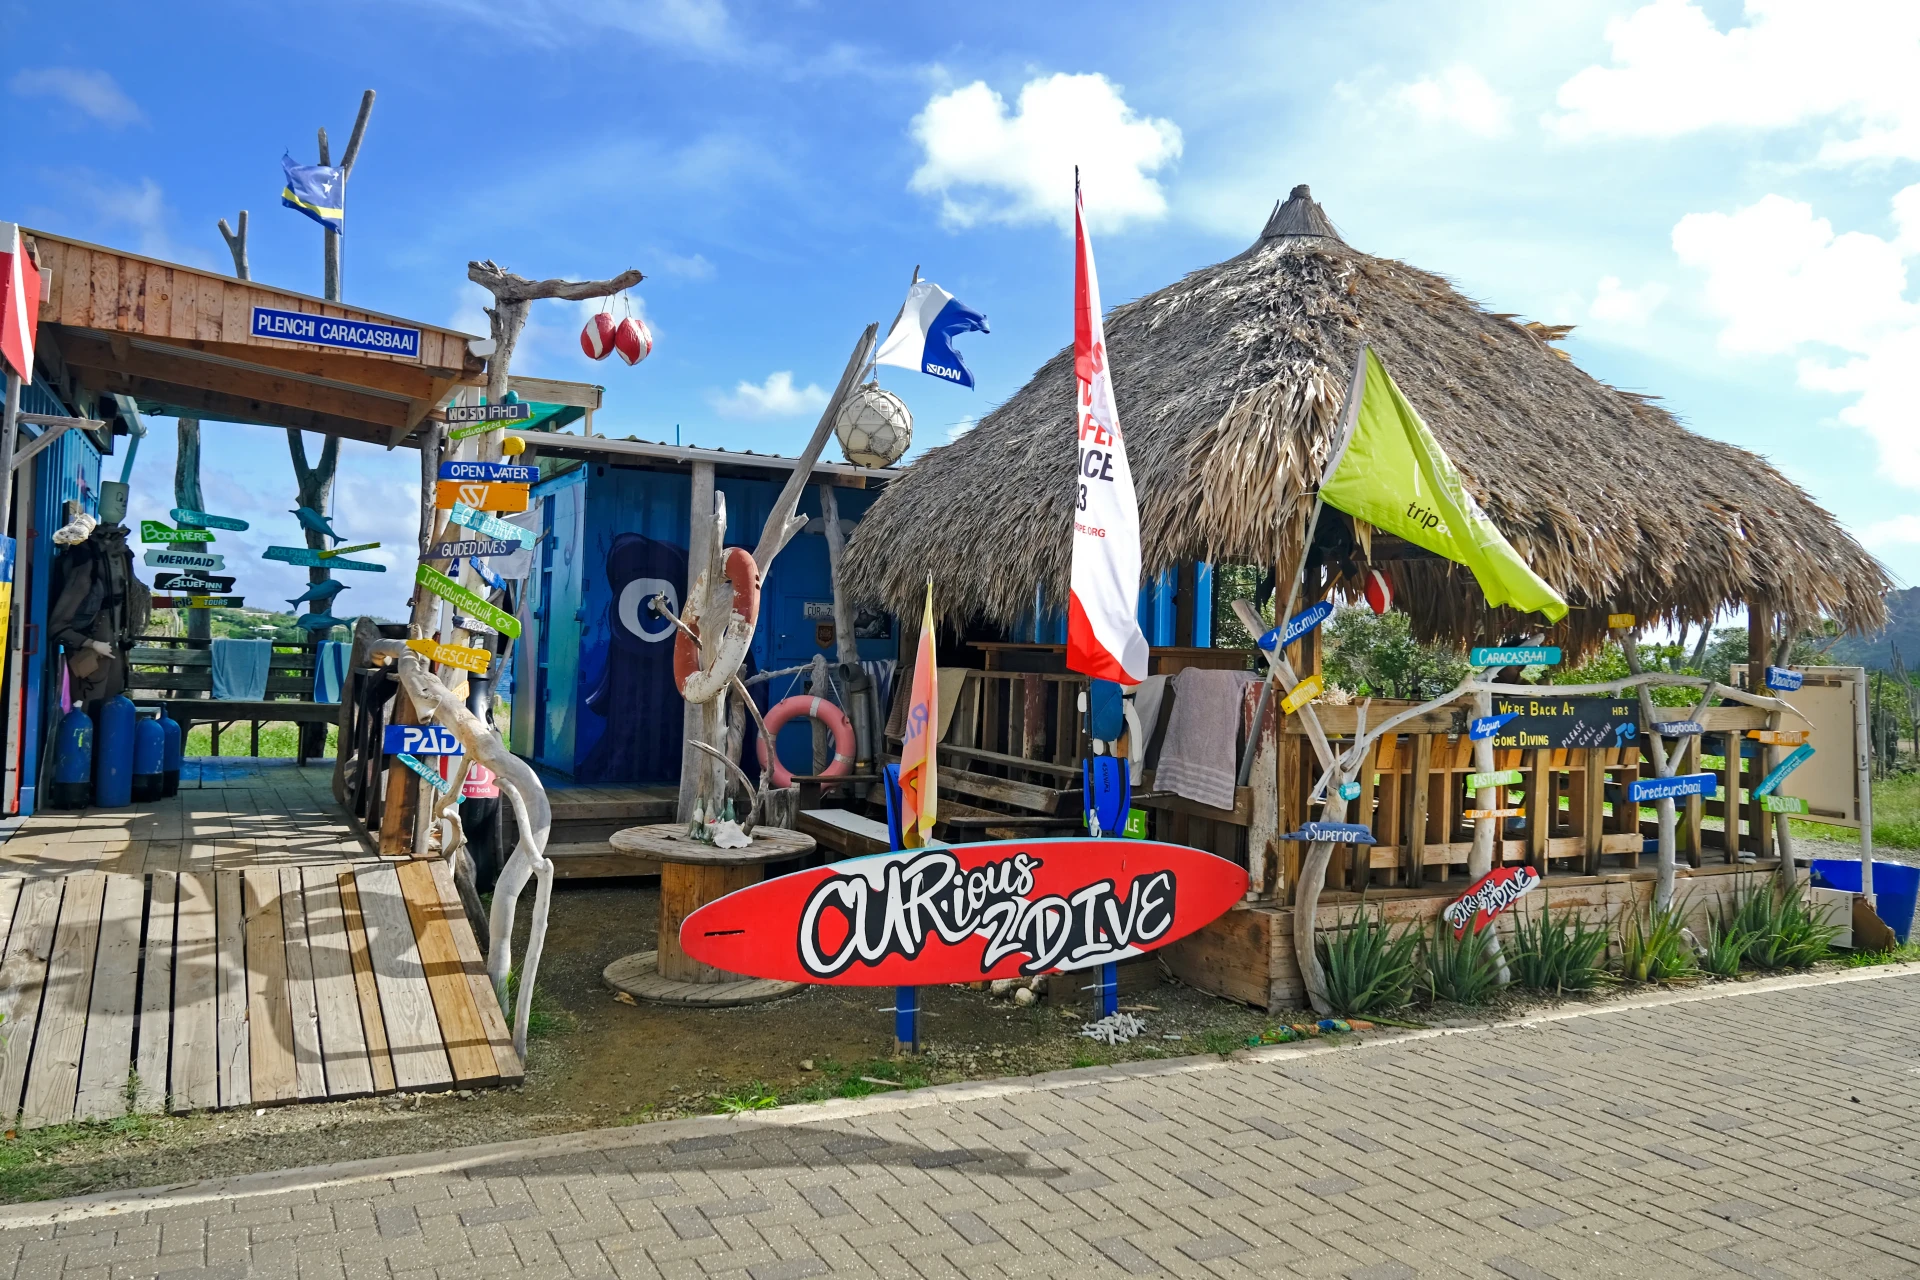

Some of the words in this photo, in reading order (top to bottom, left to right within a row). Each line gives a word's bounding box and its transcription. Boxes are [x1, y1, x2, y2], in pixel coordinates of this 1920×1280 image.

[258, 314, 315, 337] PLENCHI
[320, 323, 414, 350] CARACASBAAI
[936, 365, 961, 380] DAN
[460, 421, 502, 437] advanced
[451, 465, 485, 477] OPEN
[489, 466, 529, 479] WATER
[456, 485, 489, 508] SSI
[180, 531, 208, 542] HERE
[270, 548, 311, 558] DOLPHIN
[442, 542, 477, 556] GUIDED
[477, 541, 507, 554] DIVES
[157, 554, 214, 567] MERMAID
[292, 557, 321, 567] SCUBA
[326, 559, 376, 571] ENCOUNTER
[204, 598, 229, 606] TOURS
[421, 570, 493, 623] Introductieduik
[433, 645, 483, 669] RESCUE
[1478, 648, 1547, 665] CARACASBAAI
[1612, 706, 1629, 716] HRS
[1561, 720, 1586, 748] PLEASE
[1578, 726, 1596, 746] CALL
[1593, 723, 1612, 747] AGAIN
[1664, 722, 1700, 736] Tugboat
[1634, 780, 1701, 801] Directeursbaai
[1767, 795, 1801, 812] PISCADO
